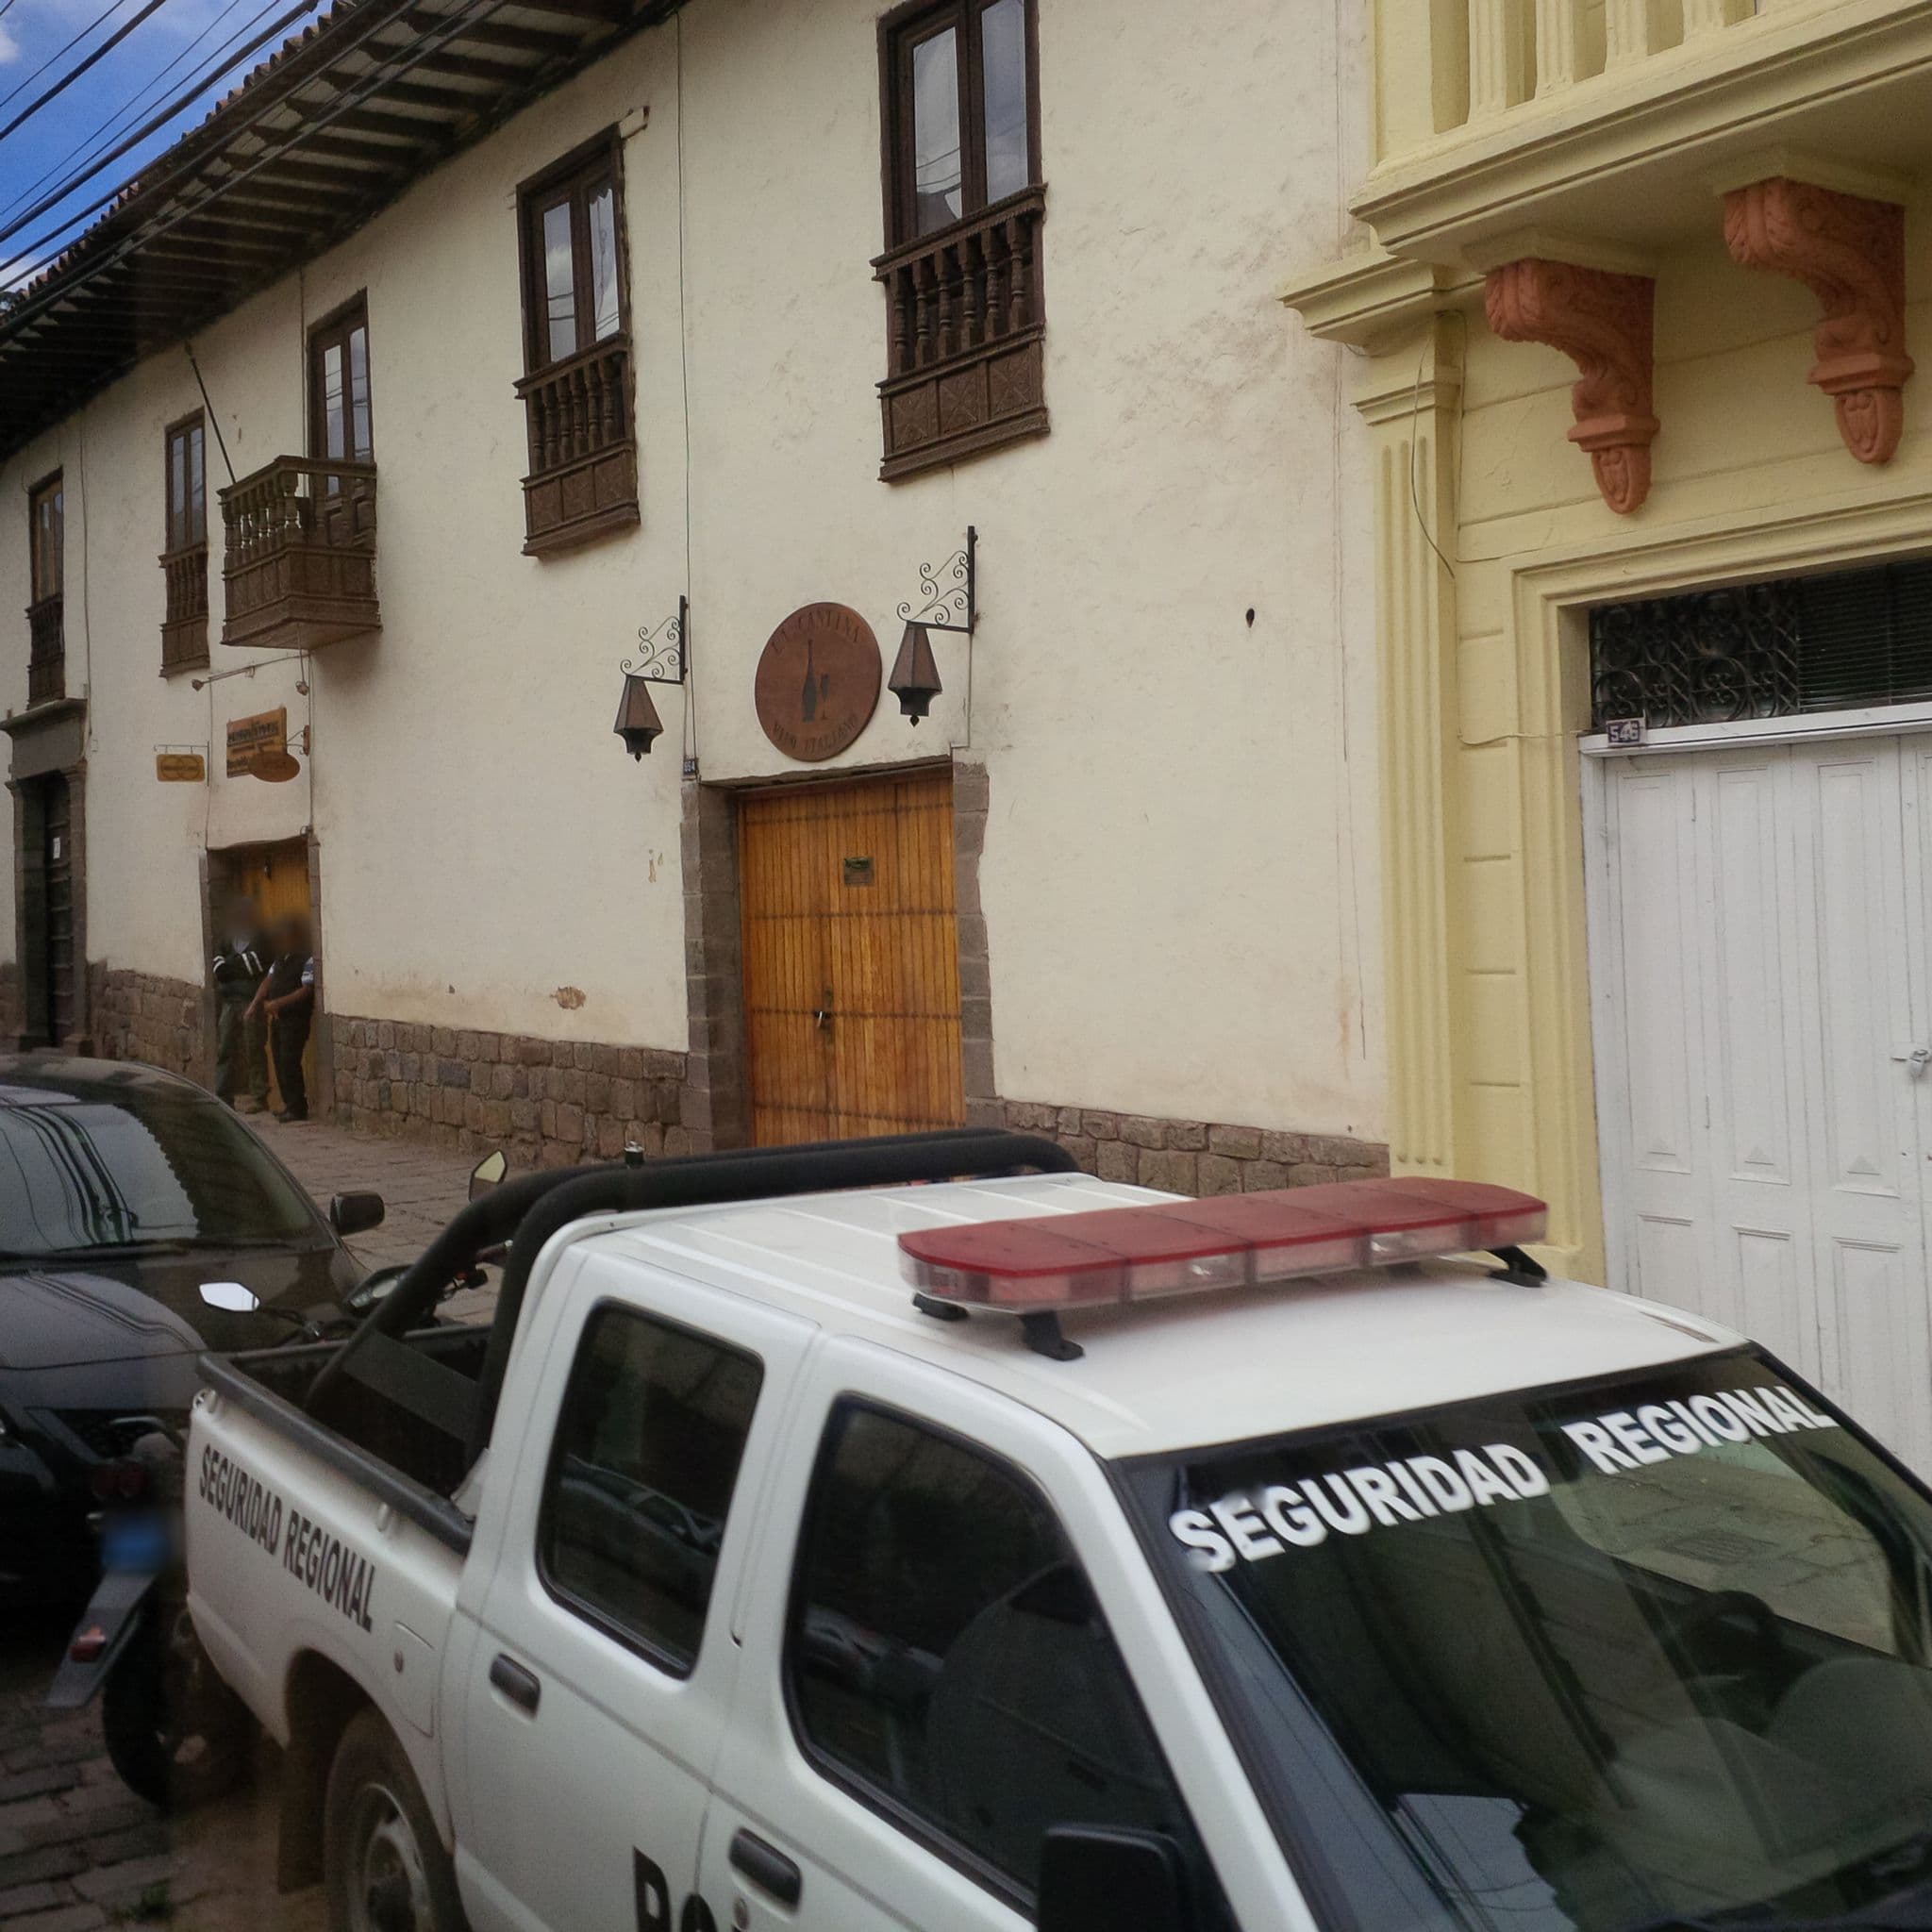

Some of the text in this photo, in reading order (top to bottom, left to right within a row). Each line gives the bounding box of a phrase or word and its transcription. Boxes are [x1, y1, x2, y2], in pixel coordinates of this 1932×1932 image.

[1610, 722, 1638, 741] 546
[199, 1443, 377, 1633] SEGURIDAD REGIONAL
[1169, 1385, 1839, 1574] SEGURIDAD REGIONAL
